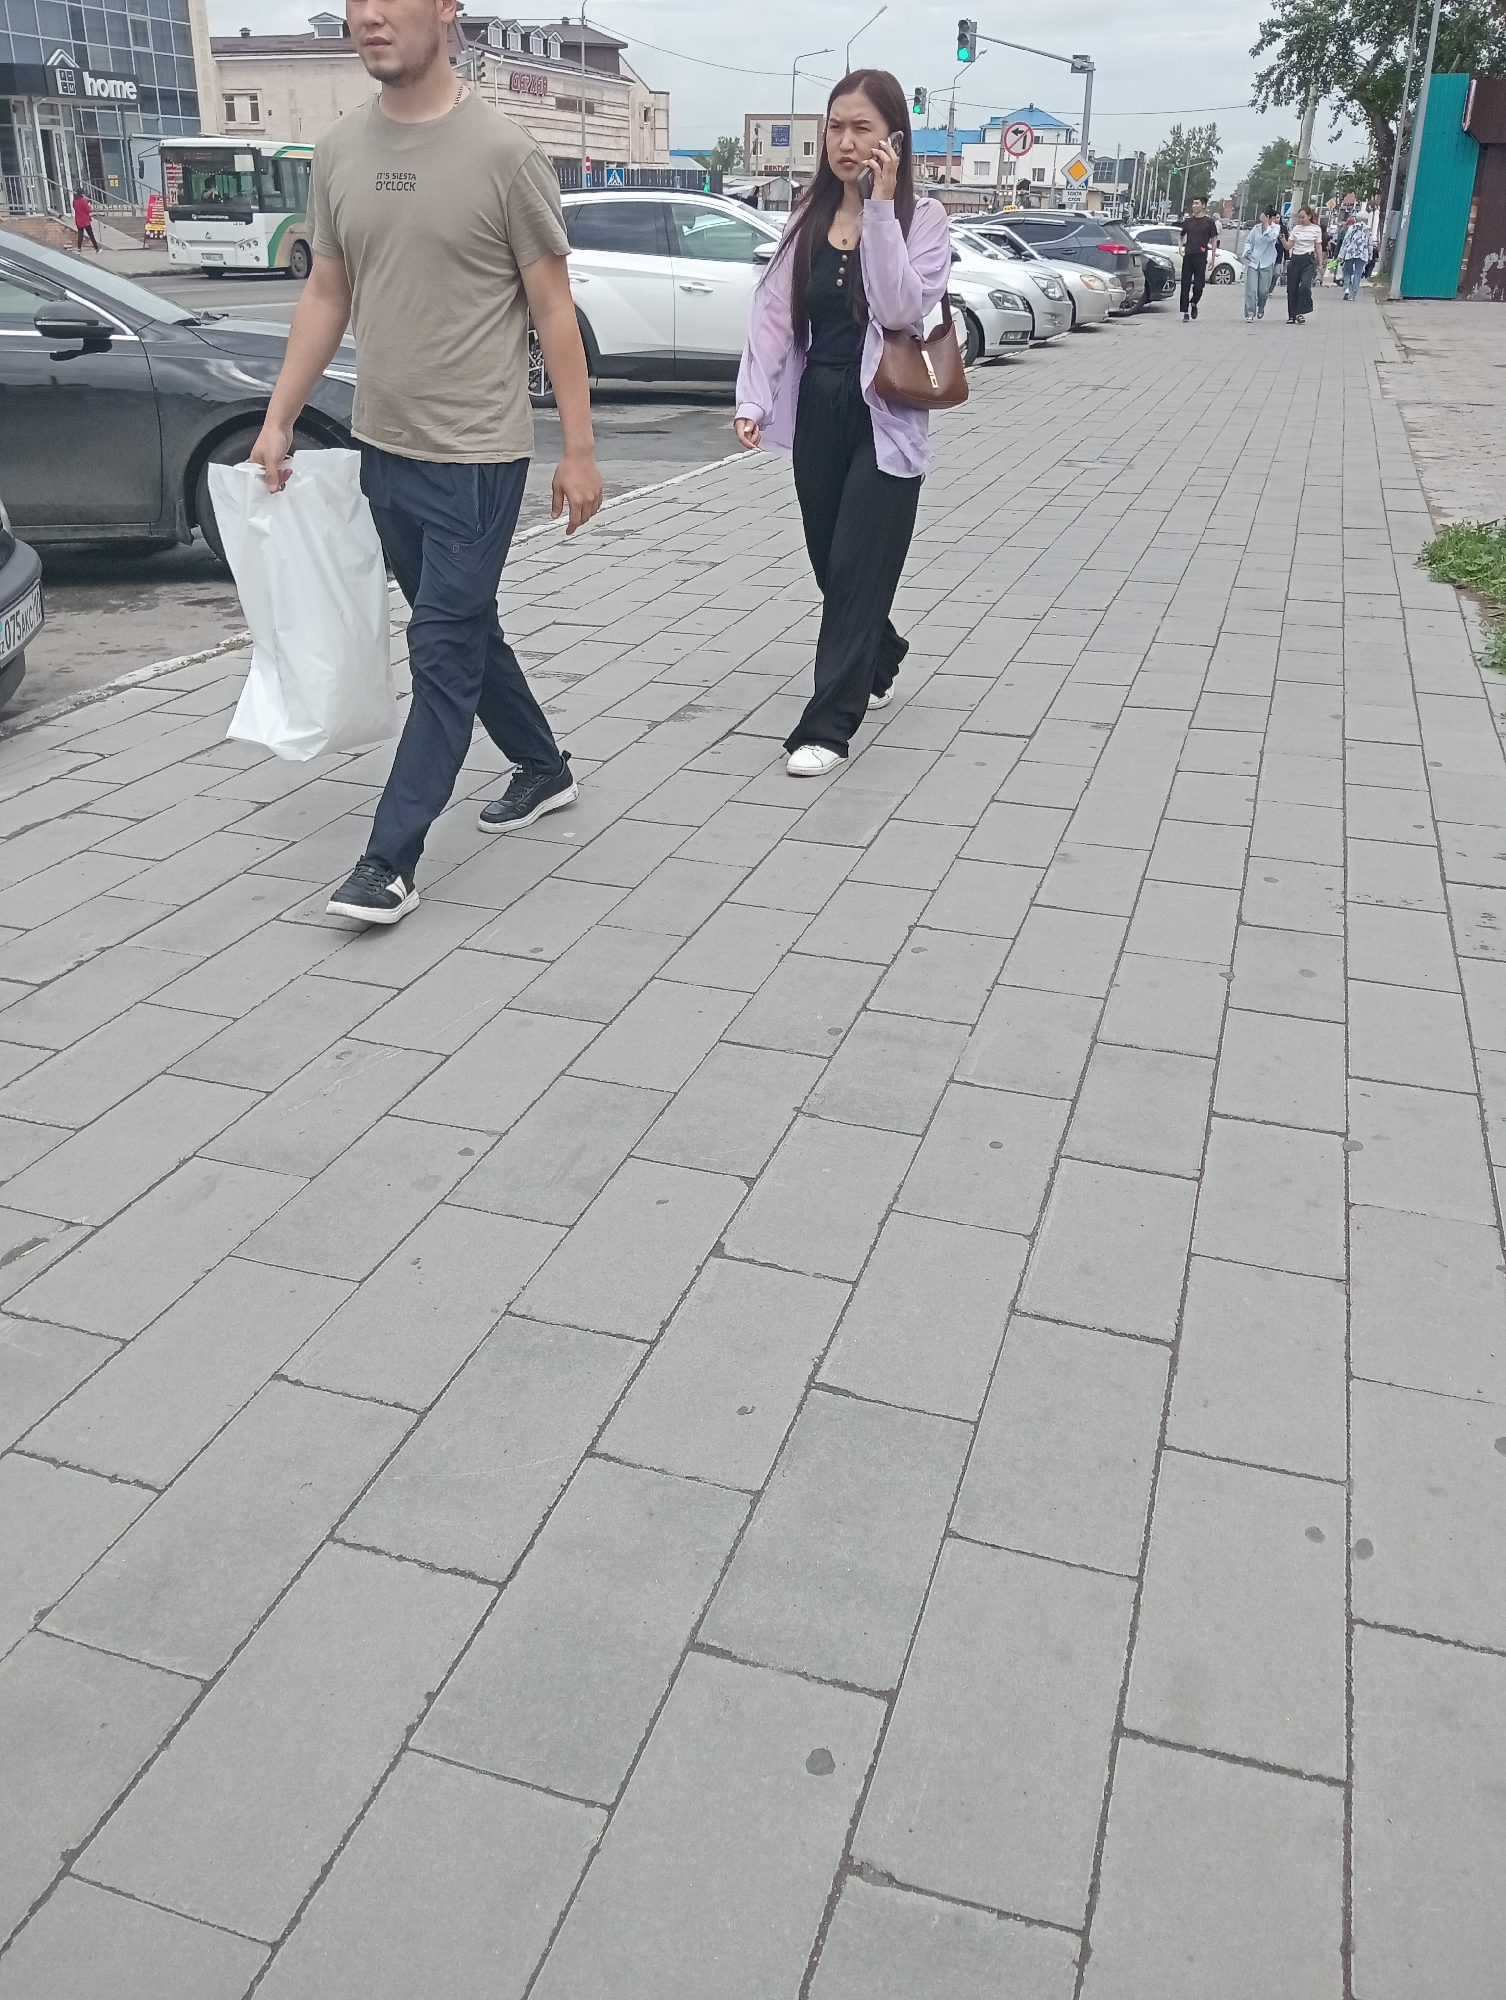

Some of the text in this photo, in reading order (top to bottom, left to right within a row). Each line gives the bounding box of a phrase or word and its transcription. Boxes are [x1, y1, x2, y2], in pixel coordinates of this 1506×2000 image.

[82, 71, 137, 99] home
[376, 172, 417, 180] IT'S SIESTA
[375, 181, 416, 191] O'CLOCK
